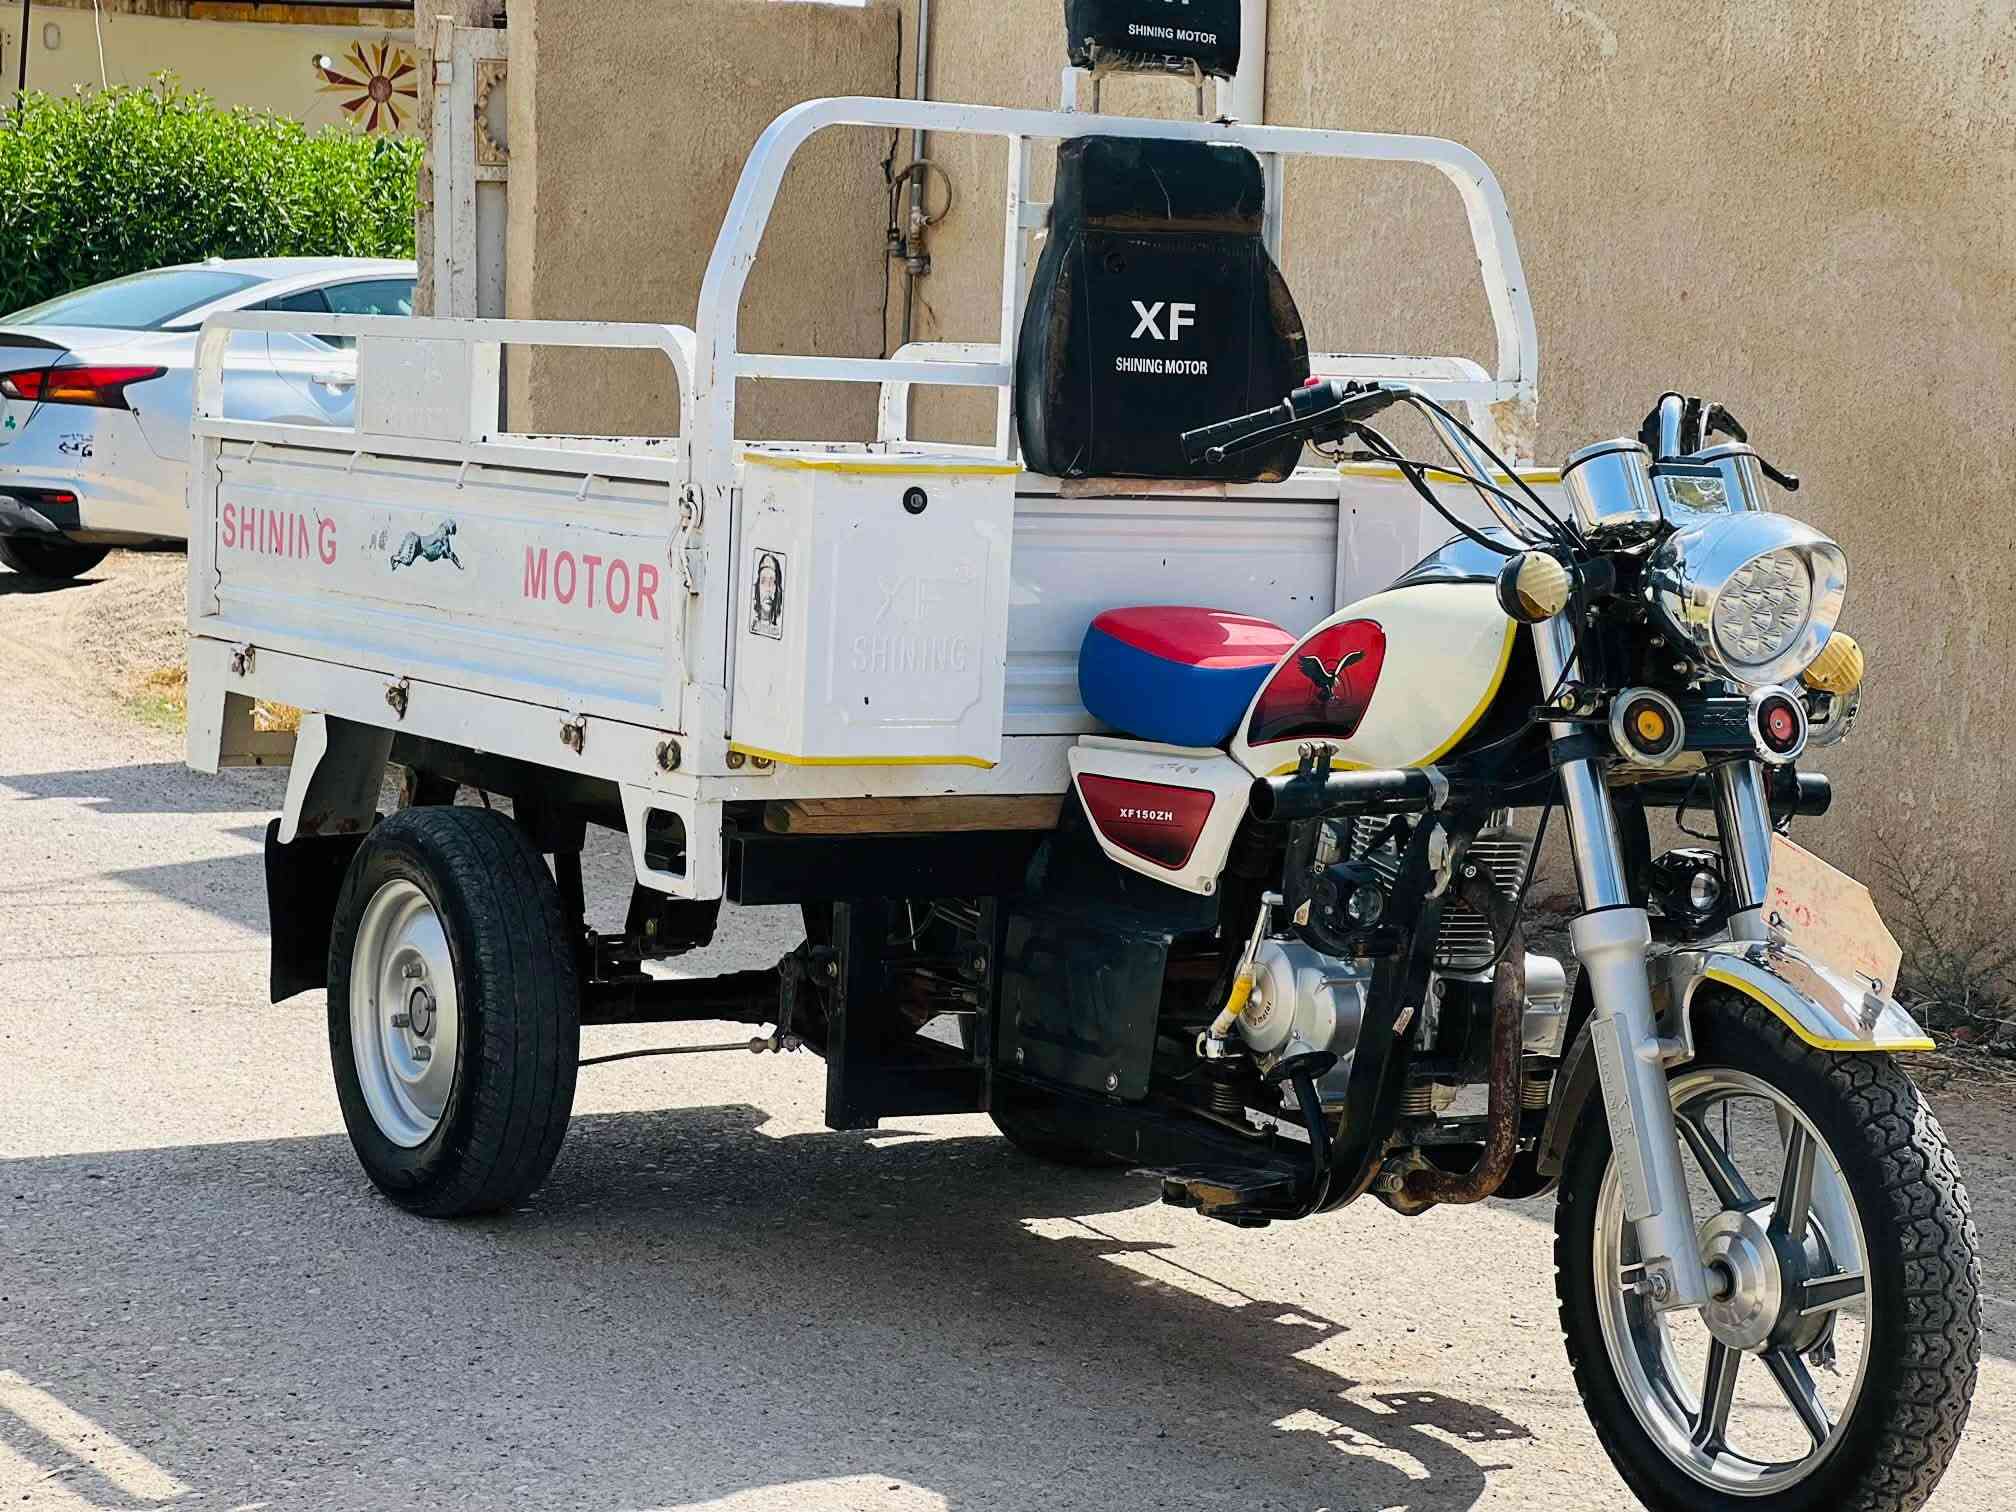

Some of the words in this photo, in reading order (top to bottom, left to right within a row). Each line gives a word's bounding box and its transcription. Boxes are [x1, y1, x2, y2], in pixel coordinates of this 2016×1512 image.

[1128, 24, 1173, 39] SHINING
[1176, 29, 1217, 44] MOTOR
[1130, 300, 1196, 341] XF
[1115, 356, 1163, 373] SHINING
[1165, 360, 1208, 375] MOTOR
[523, 544, 660, 621] MOTOR
[849, 632, 969, 673] SHINING
[1119, 808, 1173, 821] XF150ZH
